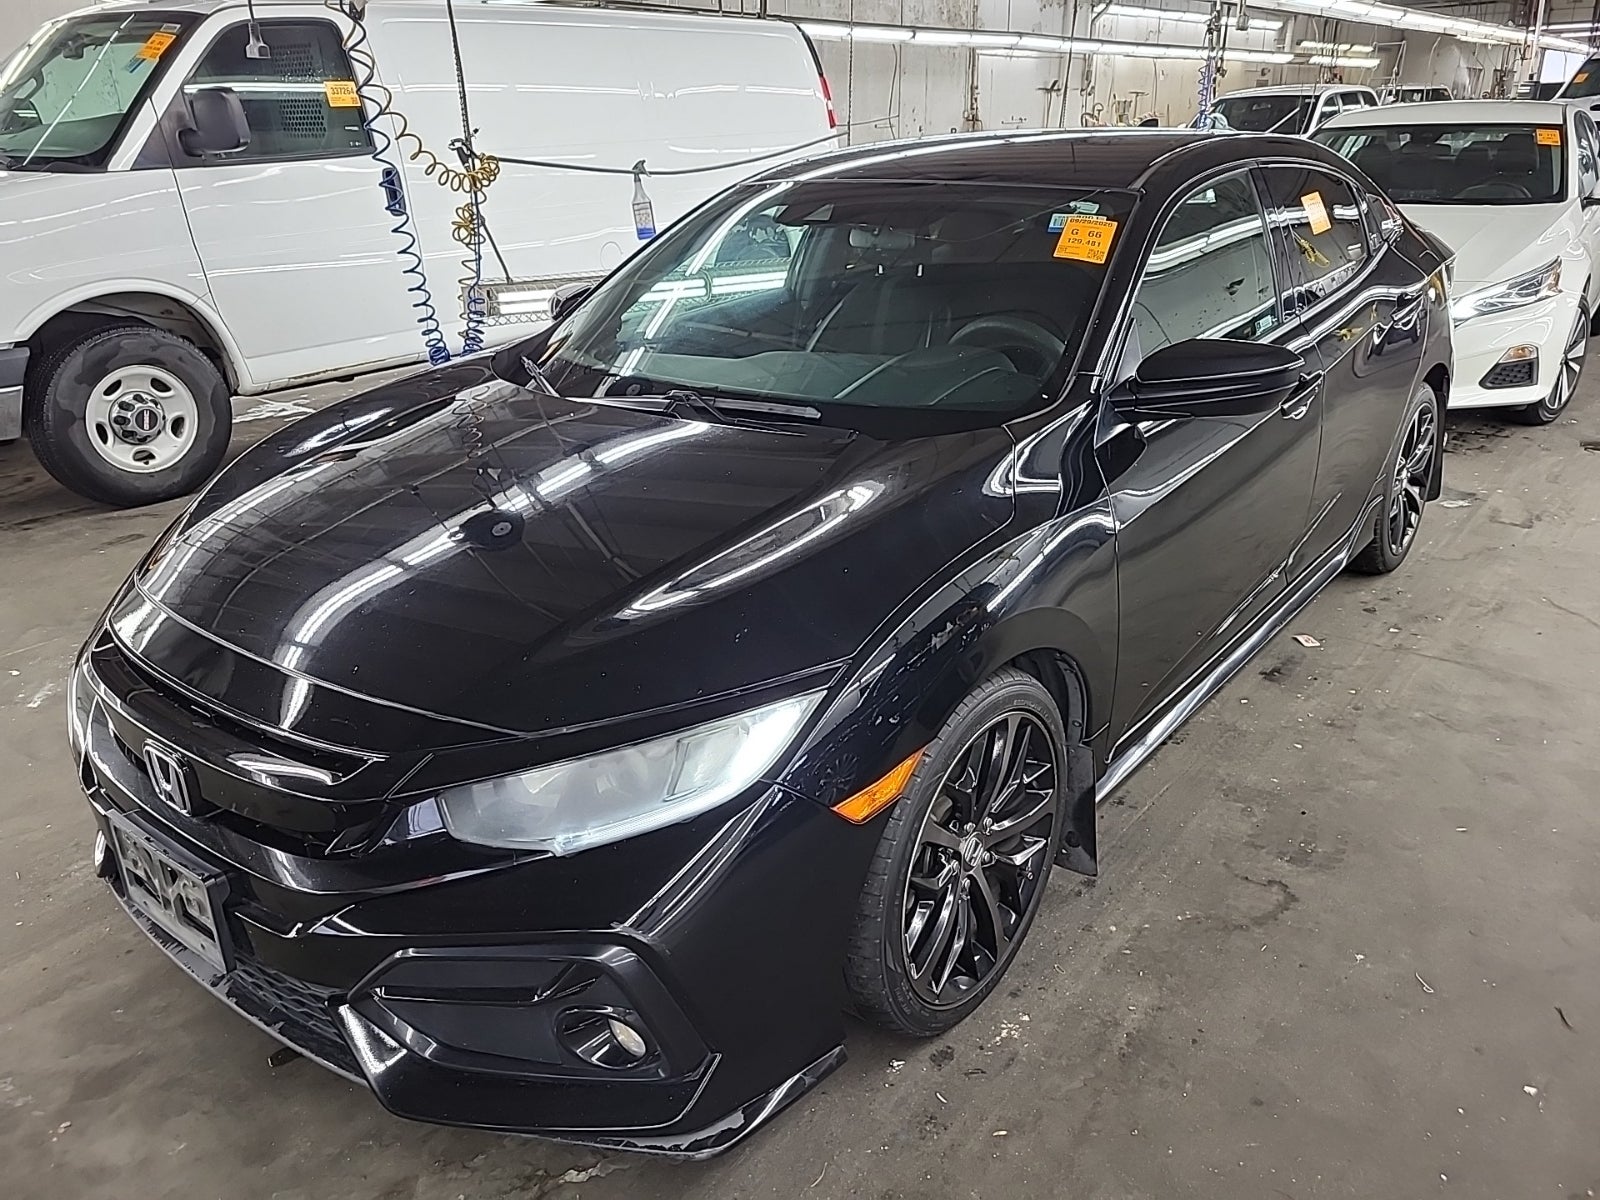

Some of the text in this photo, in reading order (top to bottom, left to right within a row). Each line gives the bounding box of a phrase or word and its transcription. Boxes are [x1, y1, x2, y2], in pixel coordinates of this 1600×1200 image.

[330, 86, 355, 95] 337264
[1071, 228, 1102, 239] G 66
